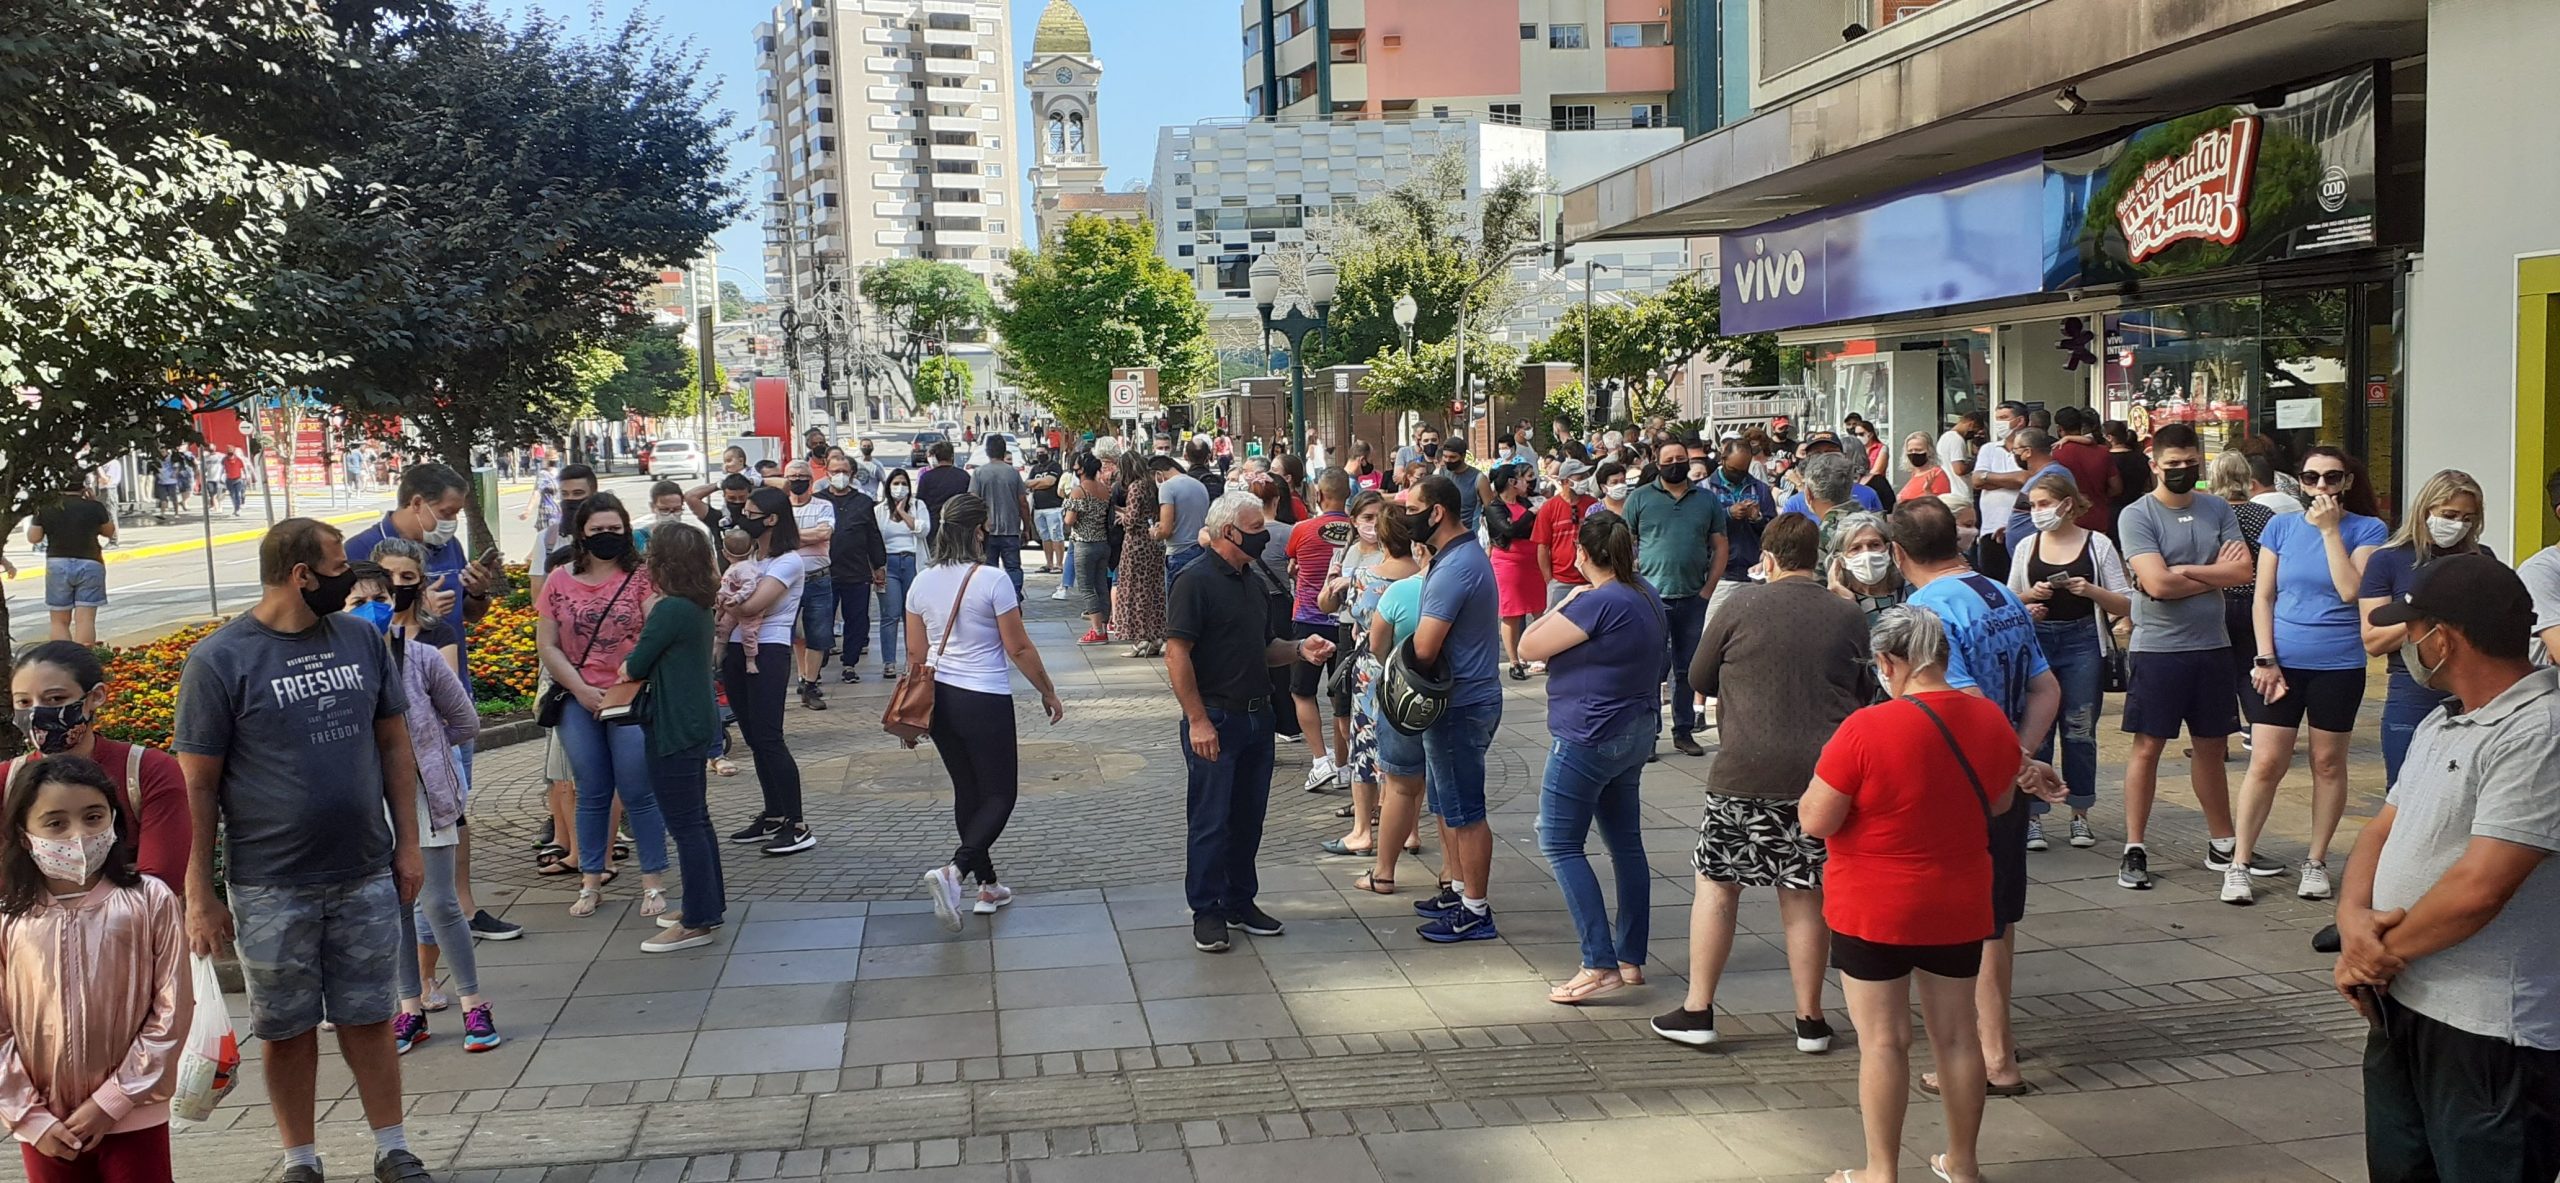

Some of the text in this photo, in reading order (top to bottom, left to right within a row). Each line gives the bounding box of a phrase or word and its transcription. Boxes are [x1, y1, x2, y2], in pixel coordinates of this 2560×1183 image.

[2117, 188, 2136, 215] Rede
[2135, 177, 2146, 193] de
[2124, 130, 2231, 233] mercadão
[2323, 181, 2345, 196] COD
[2131, 223, 2148, 251] dos
[1735, 237, 1806, 304] vivo
[1120, 389, 1128, 400] E
[271, 663, 364, 709] FREESURF
[1997, 644, 2032, 722] 10
[310, 723, 360, 745] FREEDOM
